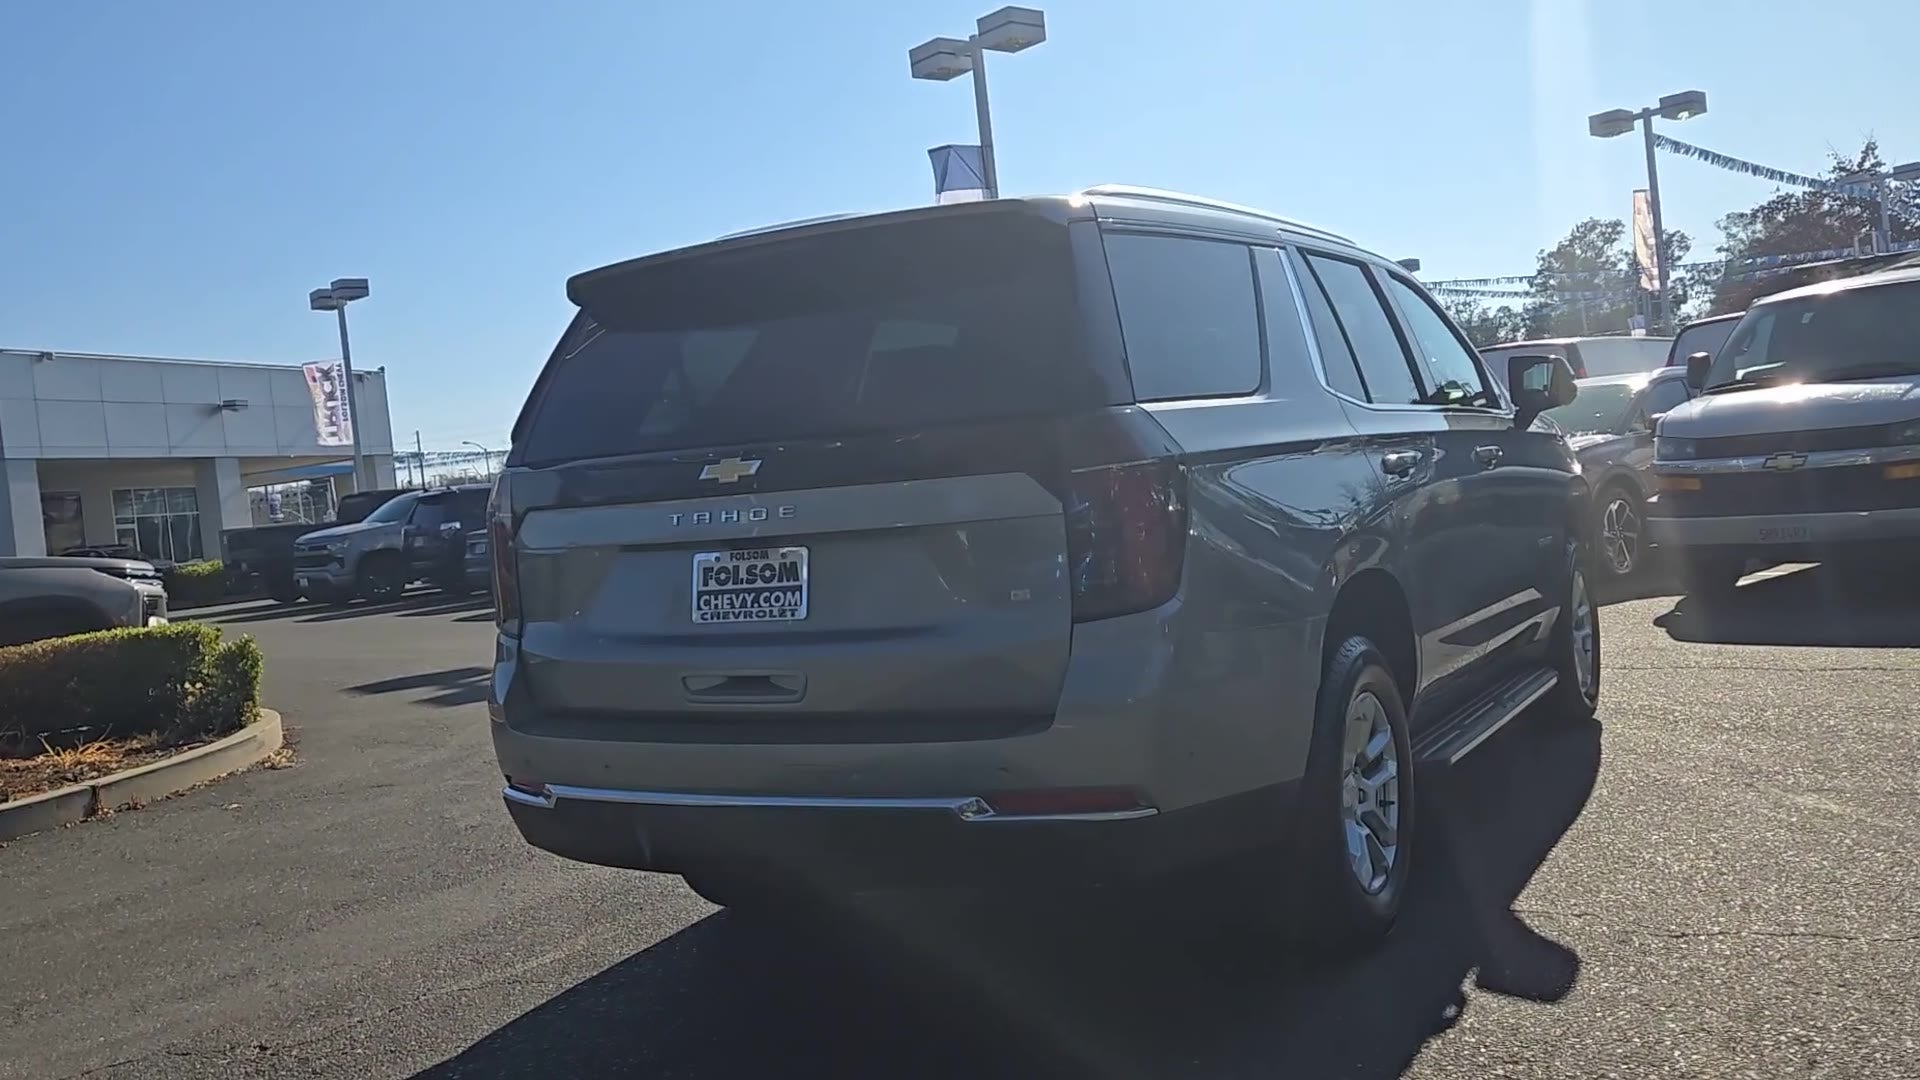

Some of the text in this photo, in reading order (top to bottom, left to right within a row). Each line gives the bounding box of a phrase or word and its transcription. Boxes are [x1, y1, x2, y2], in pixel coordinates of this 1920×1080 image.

[669, 505, 796, 526] TAHOE
[729, 550, 769, 562] FOLSOM
[702, 561, 800, 587] FOLSOM
[700, 591, 800, 610] CHEVY.COM
[701, 609, 798, 621] CHEVROLET
